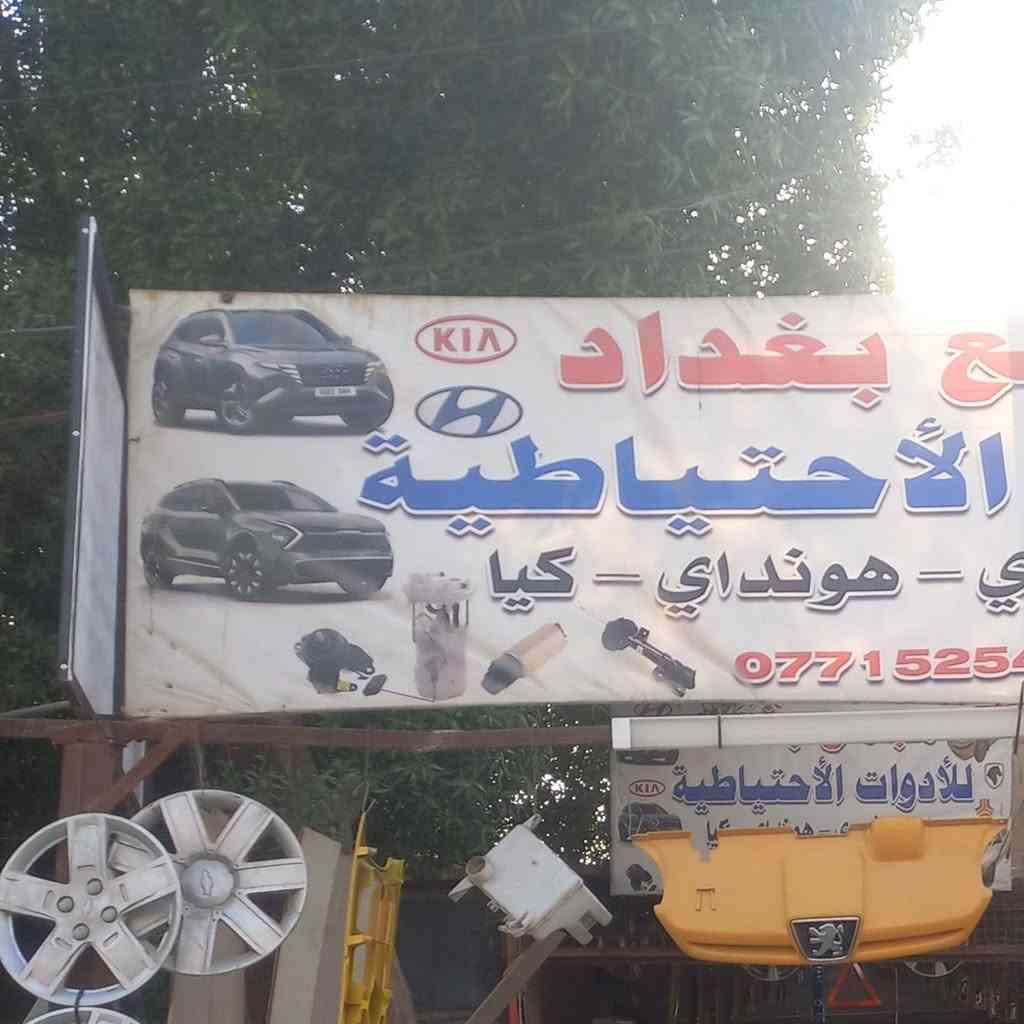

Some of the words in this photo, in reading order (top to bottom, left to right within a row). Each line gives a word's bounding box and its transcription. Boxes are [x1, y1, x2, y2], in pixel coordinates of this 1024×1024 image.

[432, 327, 501, 353] KIA
[559, 311, 891, 409] بغداد
[357, 417, 1011, 536] الأحتياطية
[488, 545, 577, 613] كيا
[656, 546, 901, 619] هونداي
[634, 782, 662, 795] KIA
[671, 756, 844, 816] الأحتياطية
[855, 756, 976, 813] للأدوات
